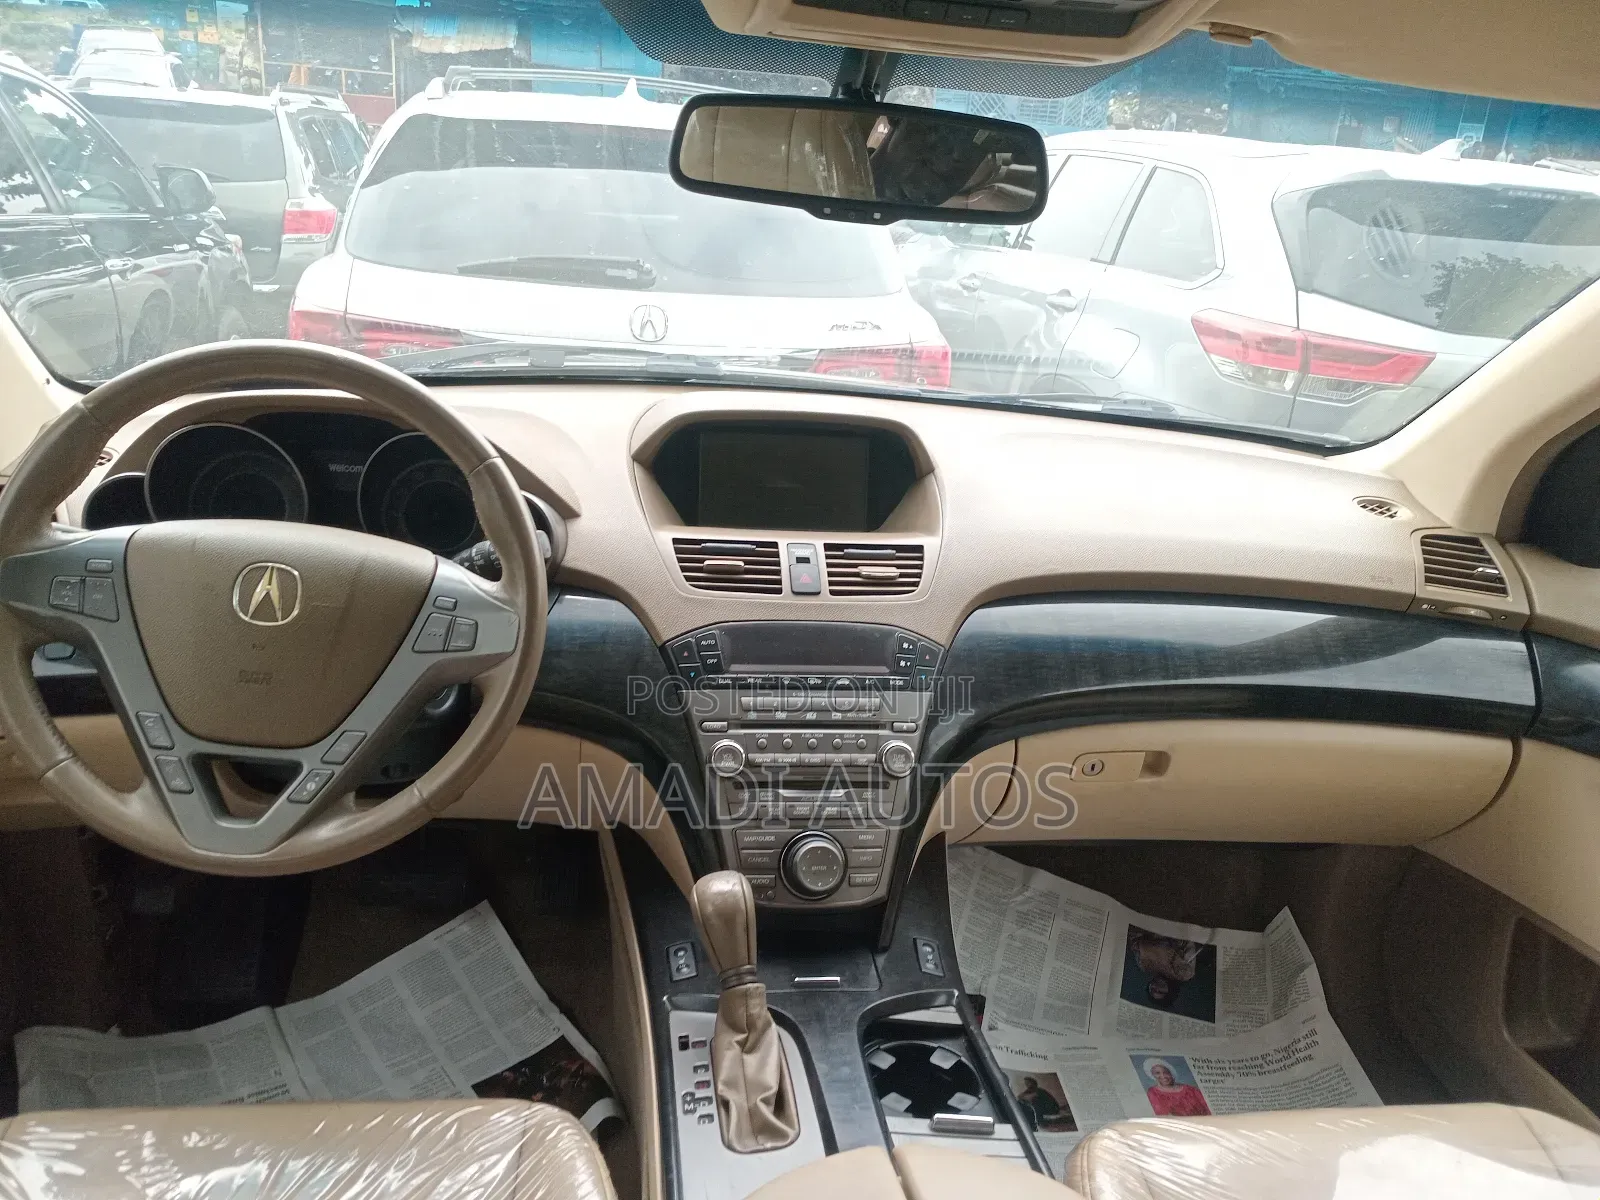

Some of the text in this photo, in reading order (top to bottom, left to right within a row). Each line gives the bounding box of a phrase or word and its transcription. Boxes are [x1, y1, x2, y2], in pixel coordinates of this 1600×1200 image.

[328, 463, 363, 473] welcom
[1004, 1045, 1049, 1061] Trafficking
[1265, 1053, 1292, 1067] World
[1291, 1039, 1320, 1057] Health
[1273, 1038, 1301, 1055] Nigeria
[1301, 1028, 1318, 1041] still
[1258, 1053, 1315, 1077] breastfeeding
